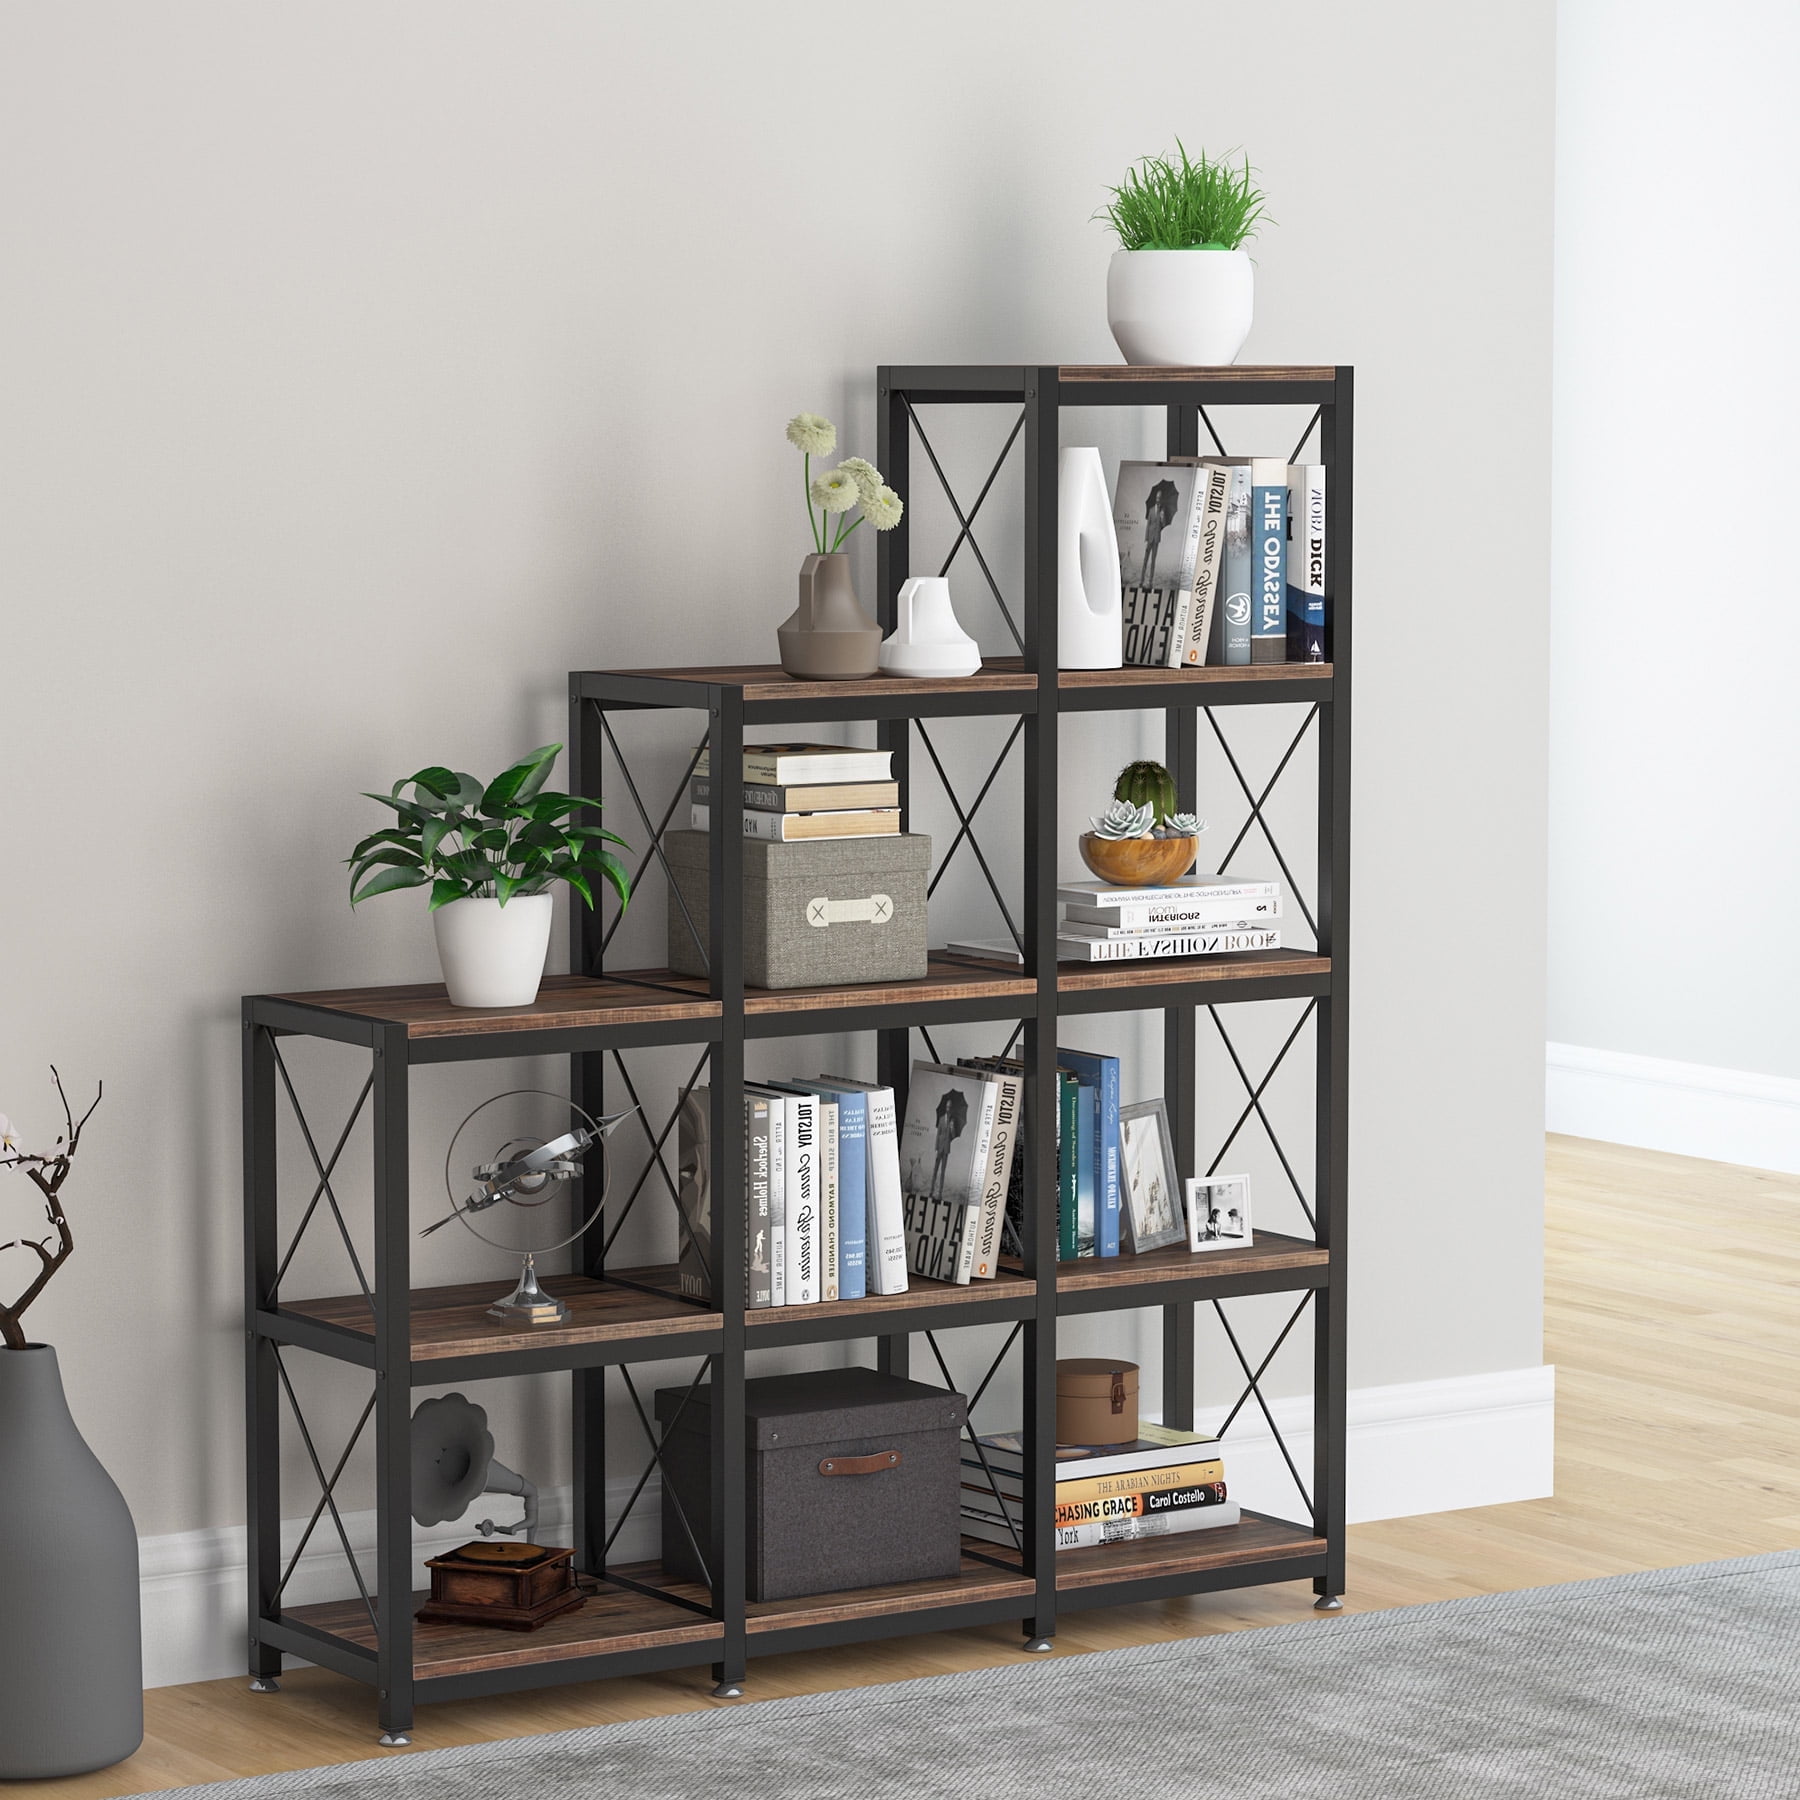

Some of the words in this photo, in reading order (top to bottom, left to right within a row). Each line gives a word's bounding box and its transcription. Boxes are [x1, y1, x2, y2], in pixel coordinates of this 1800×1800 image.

[1096, 1482, 1113, 1494] THE
[1115, 1476, 1149, 1491] ARABIAN
[1151, 1471, 1181, 1486] NIGHTS
[1103, 1497, 1138, 1515] GRACE
[1150, 1493, 1171, 1509] Carol
[1172, 1489, 1205, 1505] Costello
[1057, 1526, 1079, 1545] York
